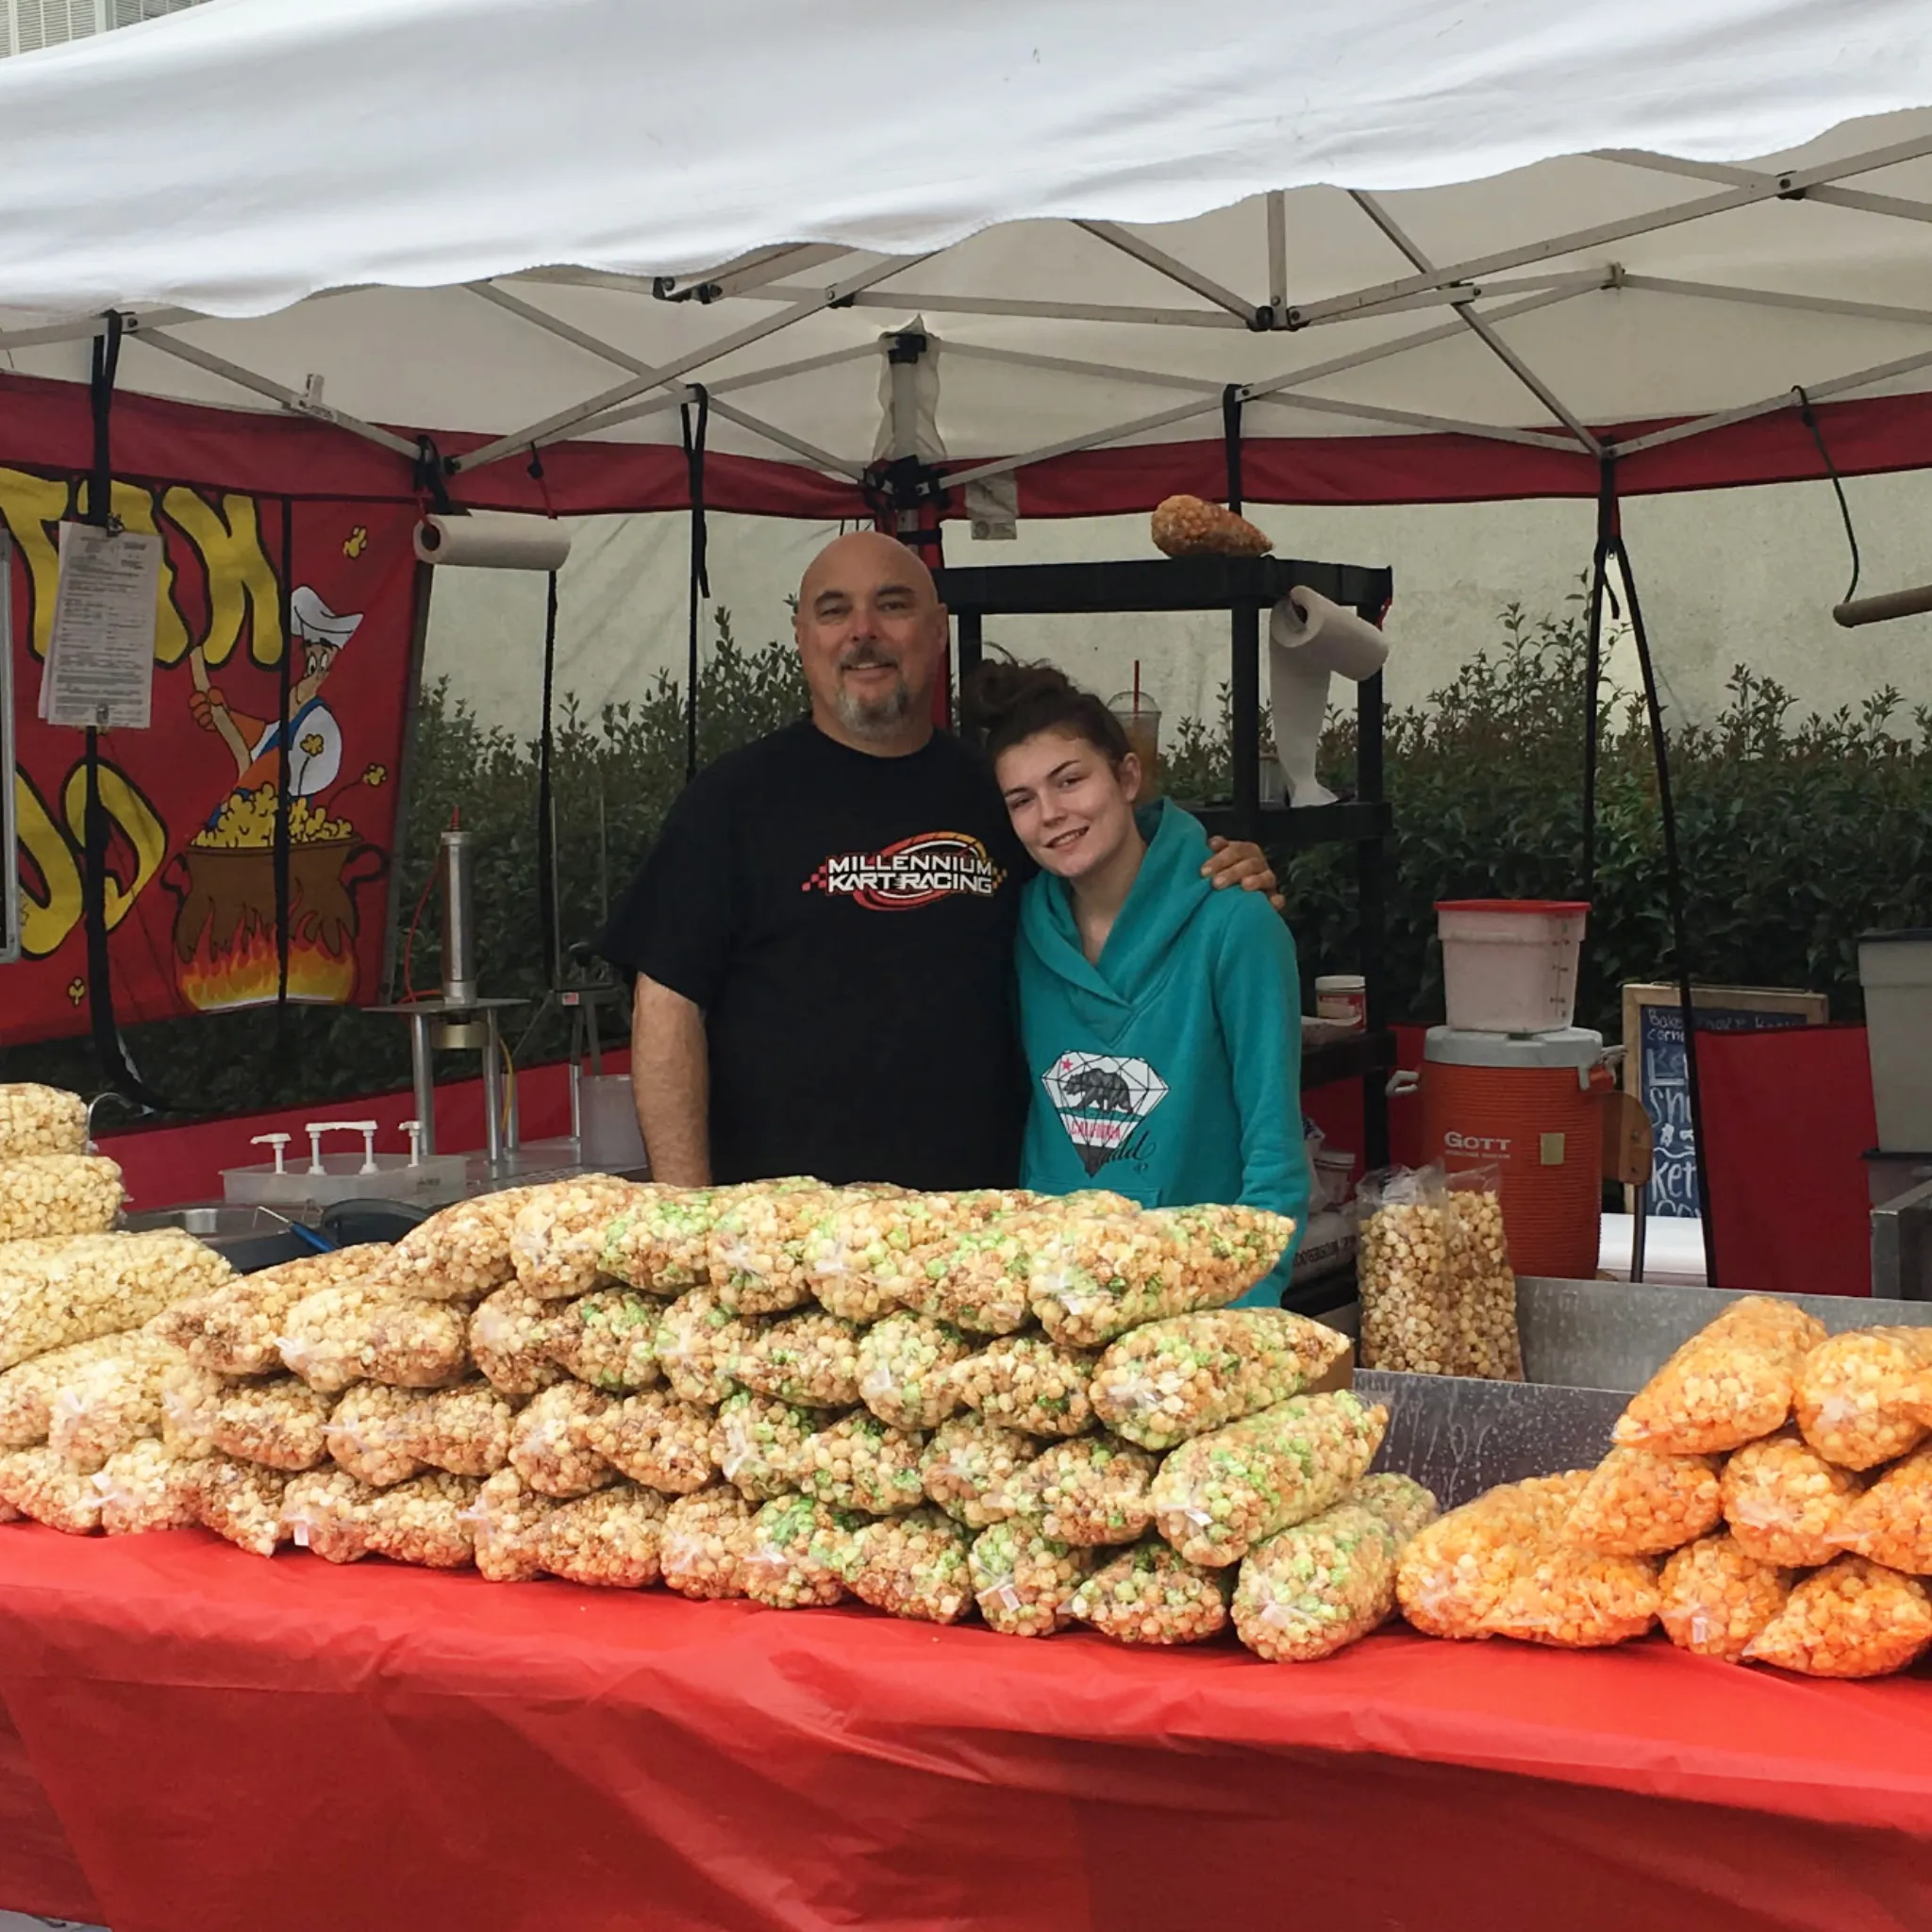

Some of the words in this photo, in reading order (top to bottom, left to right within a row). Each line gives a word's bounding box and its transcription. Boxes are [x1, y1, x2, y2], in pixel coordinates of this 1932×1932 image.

[828, 856, 992, 875] MILLENNIUM
[828, 874, 891, 893] KART
[897, 874, 991, 893] RACING
